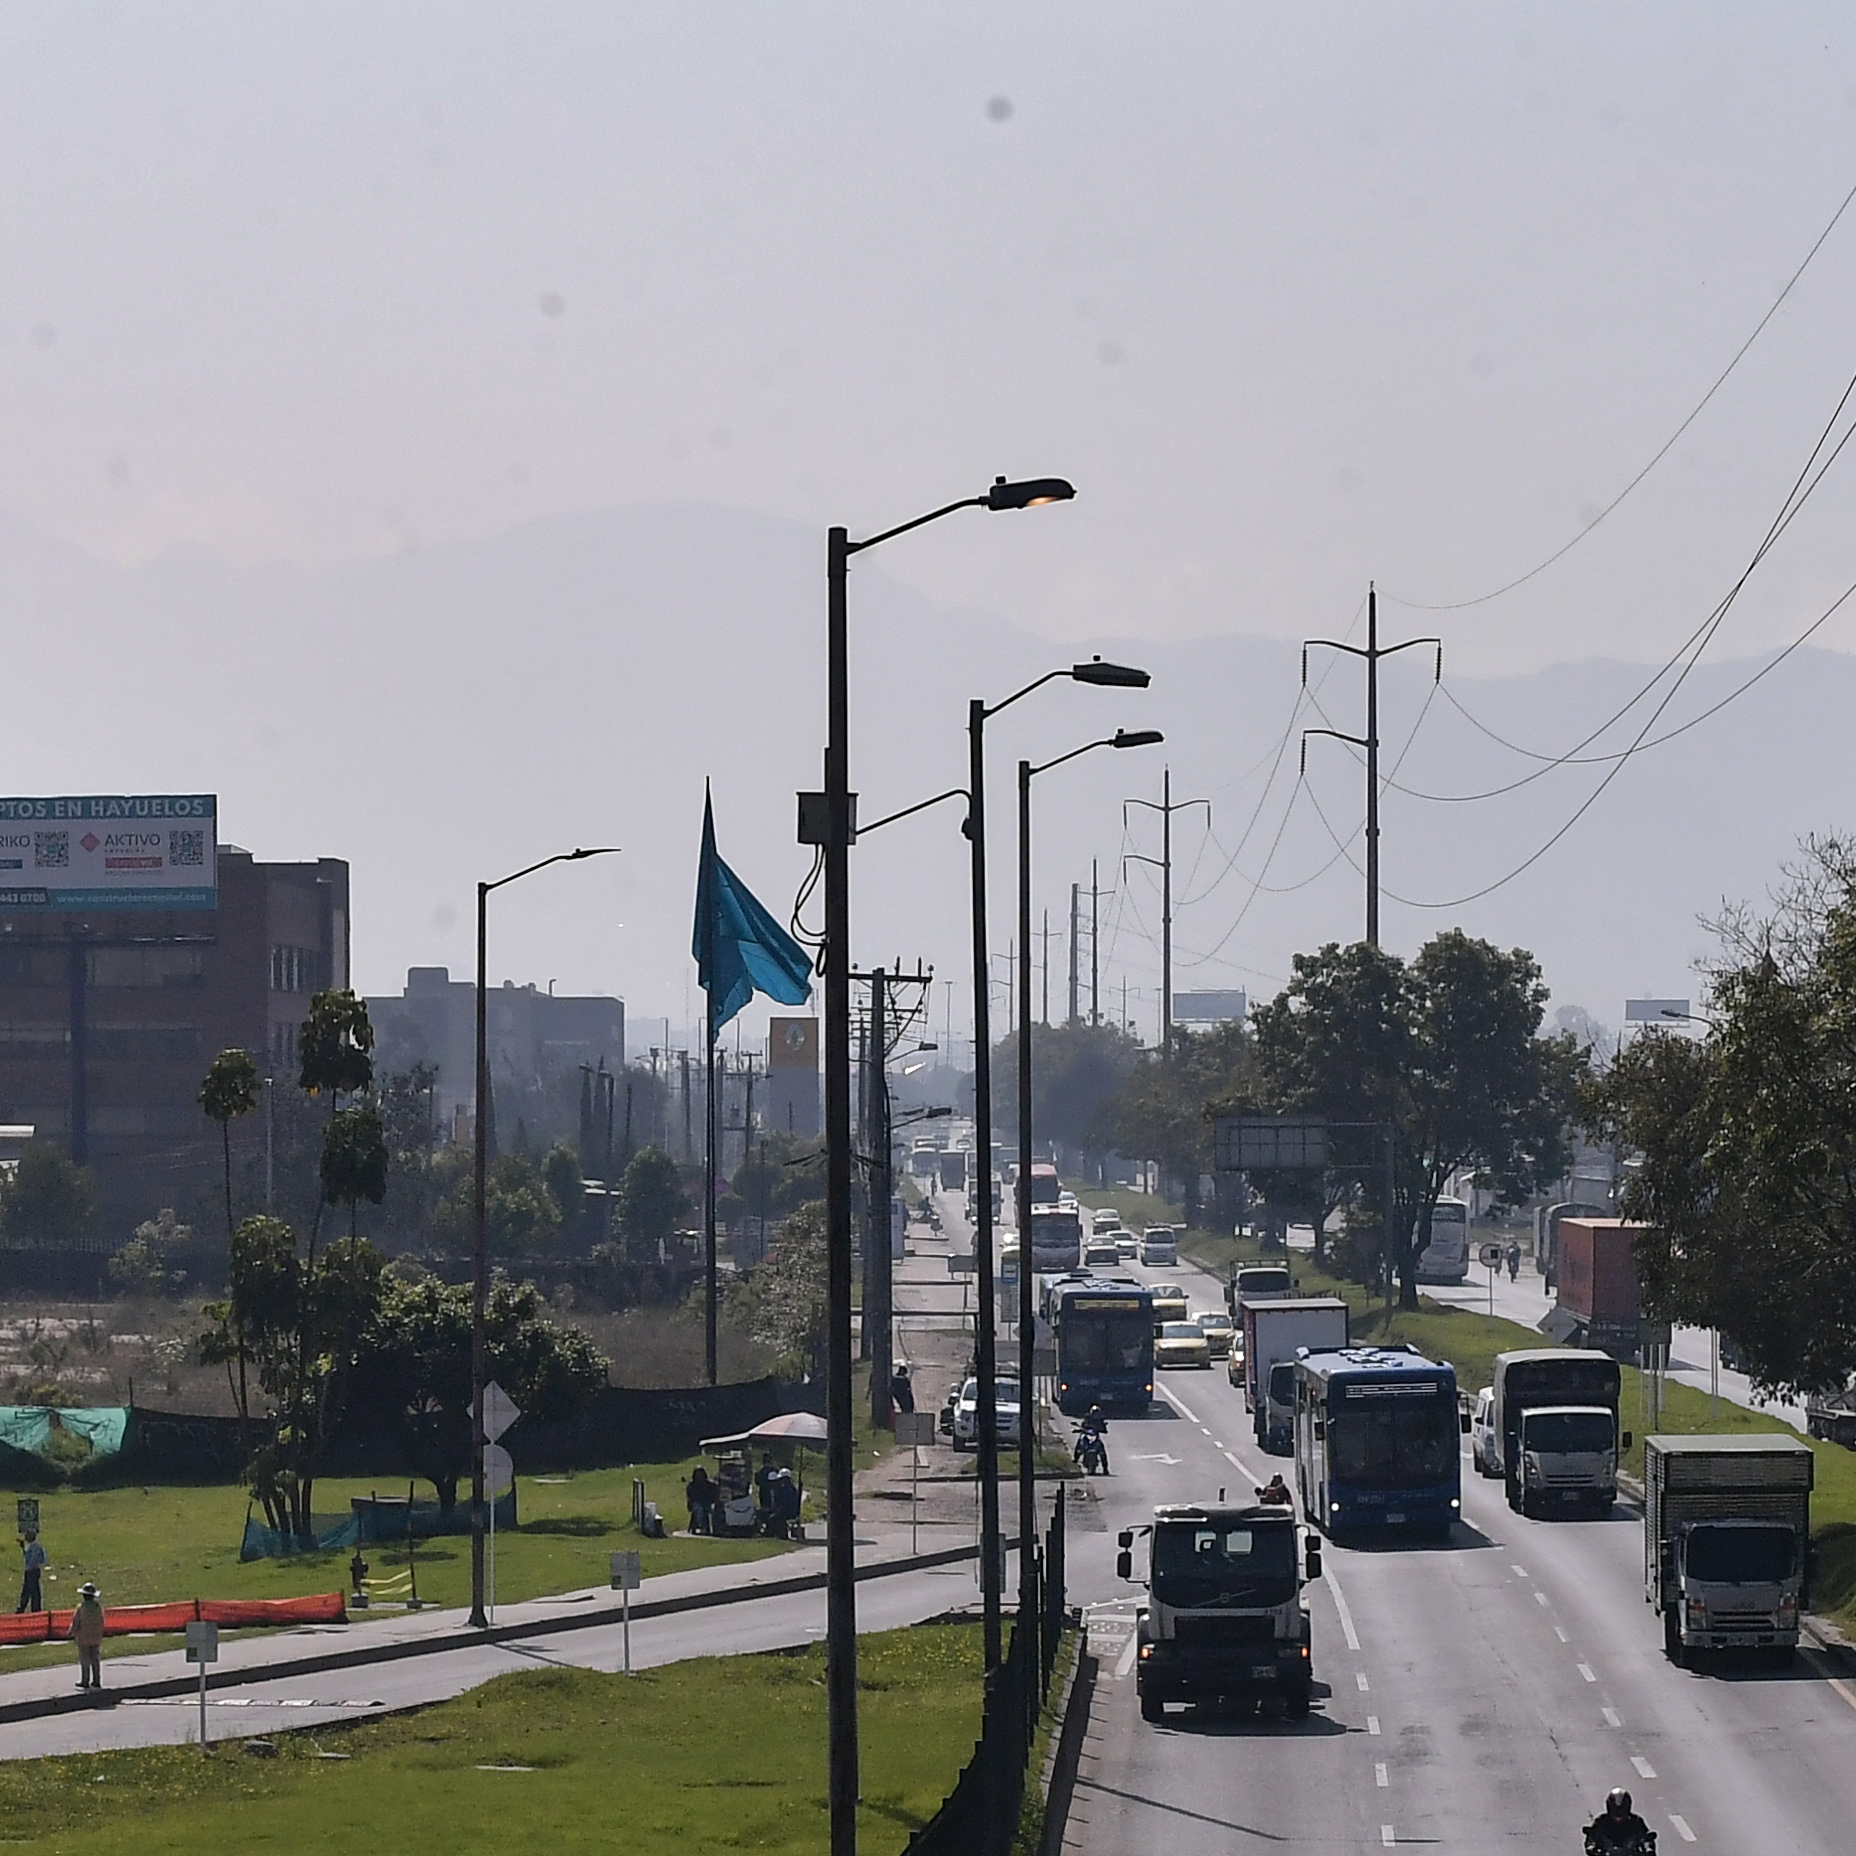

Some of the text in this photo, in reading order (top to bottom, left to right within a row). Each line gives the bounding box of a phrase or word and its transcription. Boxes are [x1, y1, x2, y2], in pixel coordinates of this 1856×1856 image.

[54, 800, 82, 817] EN
[91, 799, 204, 816] HAYUELOS
[104, 833, 161, 847] AKTIVO
